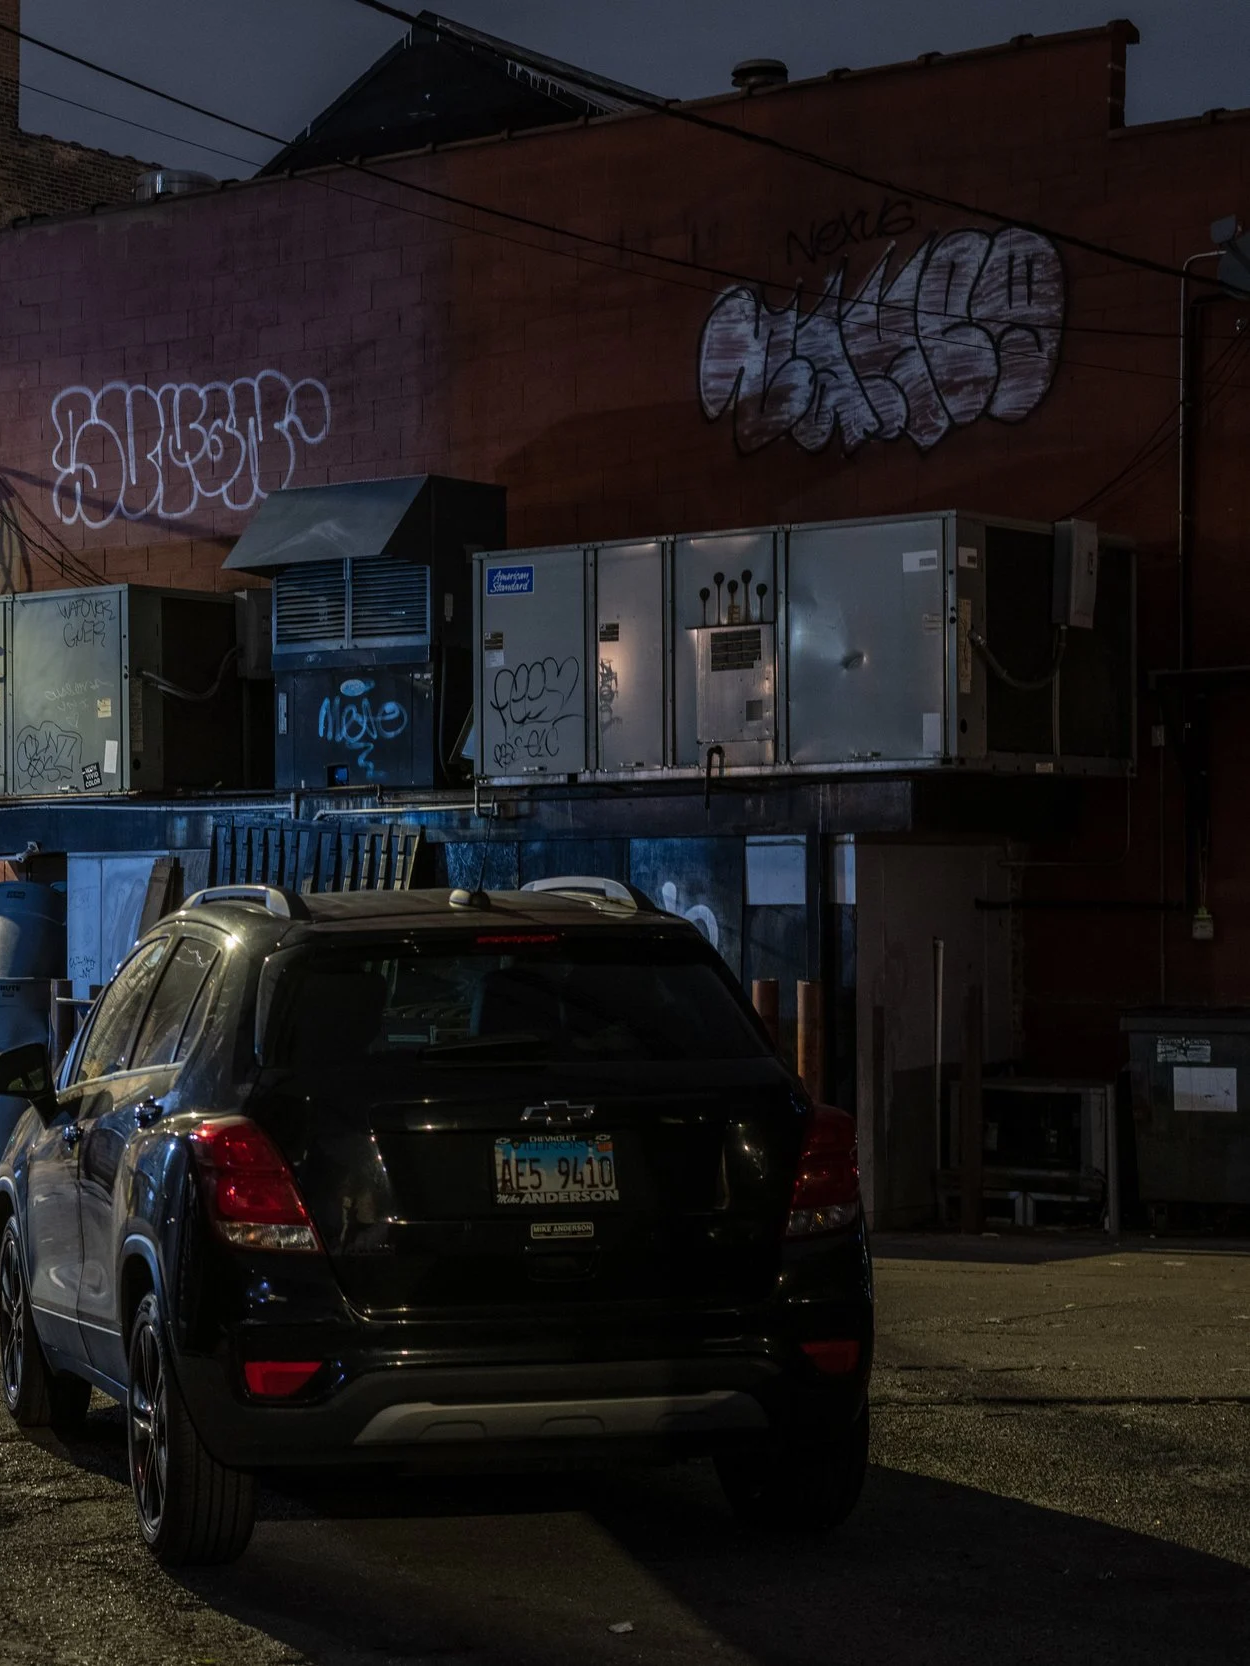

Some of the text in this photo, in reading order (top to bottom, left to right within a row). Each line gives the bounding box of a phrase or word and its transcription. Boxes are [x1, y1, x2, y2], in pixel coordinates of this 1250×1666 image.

[493, 569, 530, 582] American
[490, 578, 531, 593] Standard
[529, 1135, 578, 1143] CHEVROLET
[557, 1156, 613, 1189] 9410
[496, 1189, 620, 1205] Mike ANDERSON
[533, 1223, 592, 1233] MIKE ANDERSON
